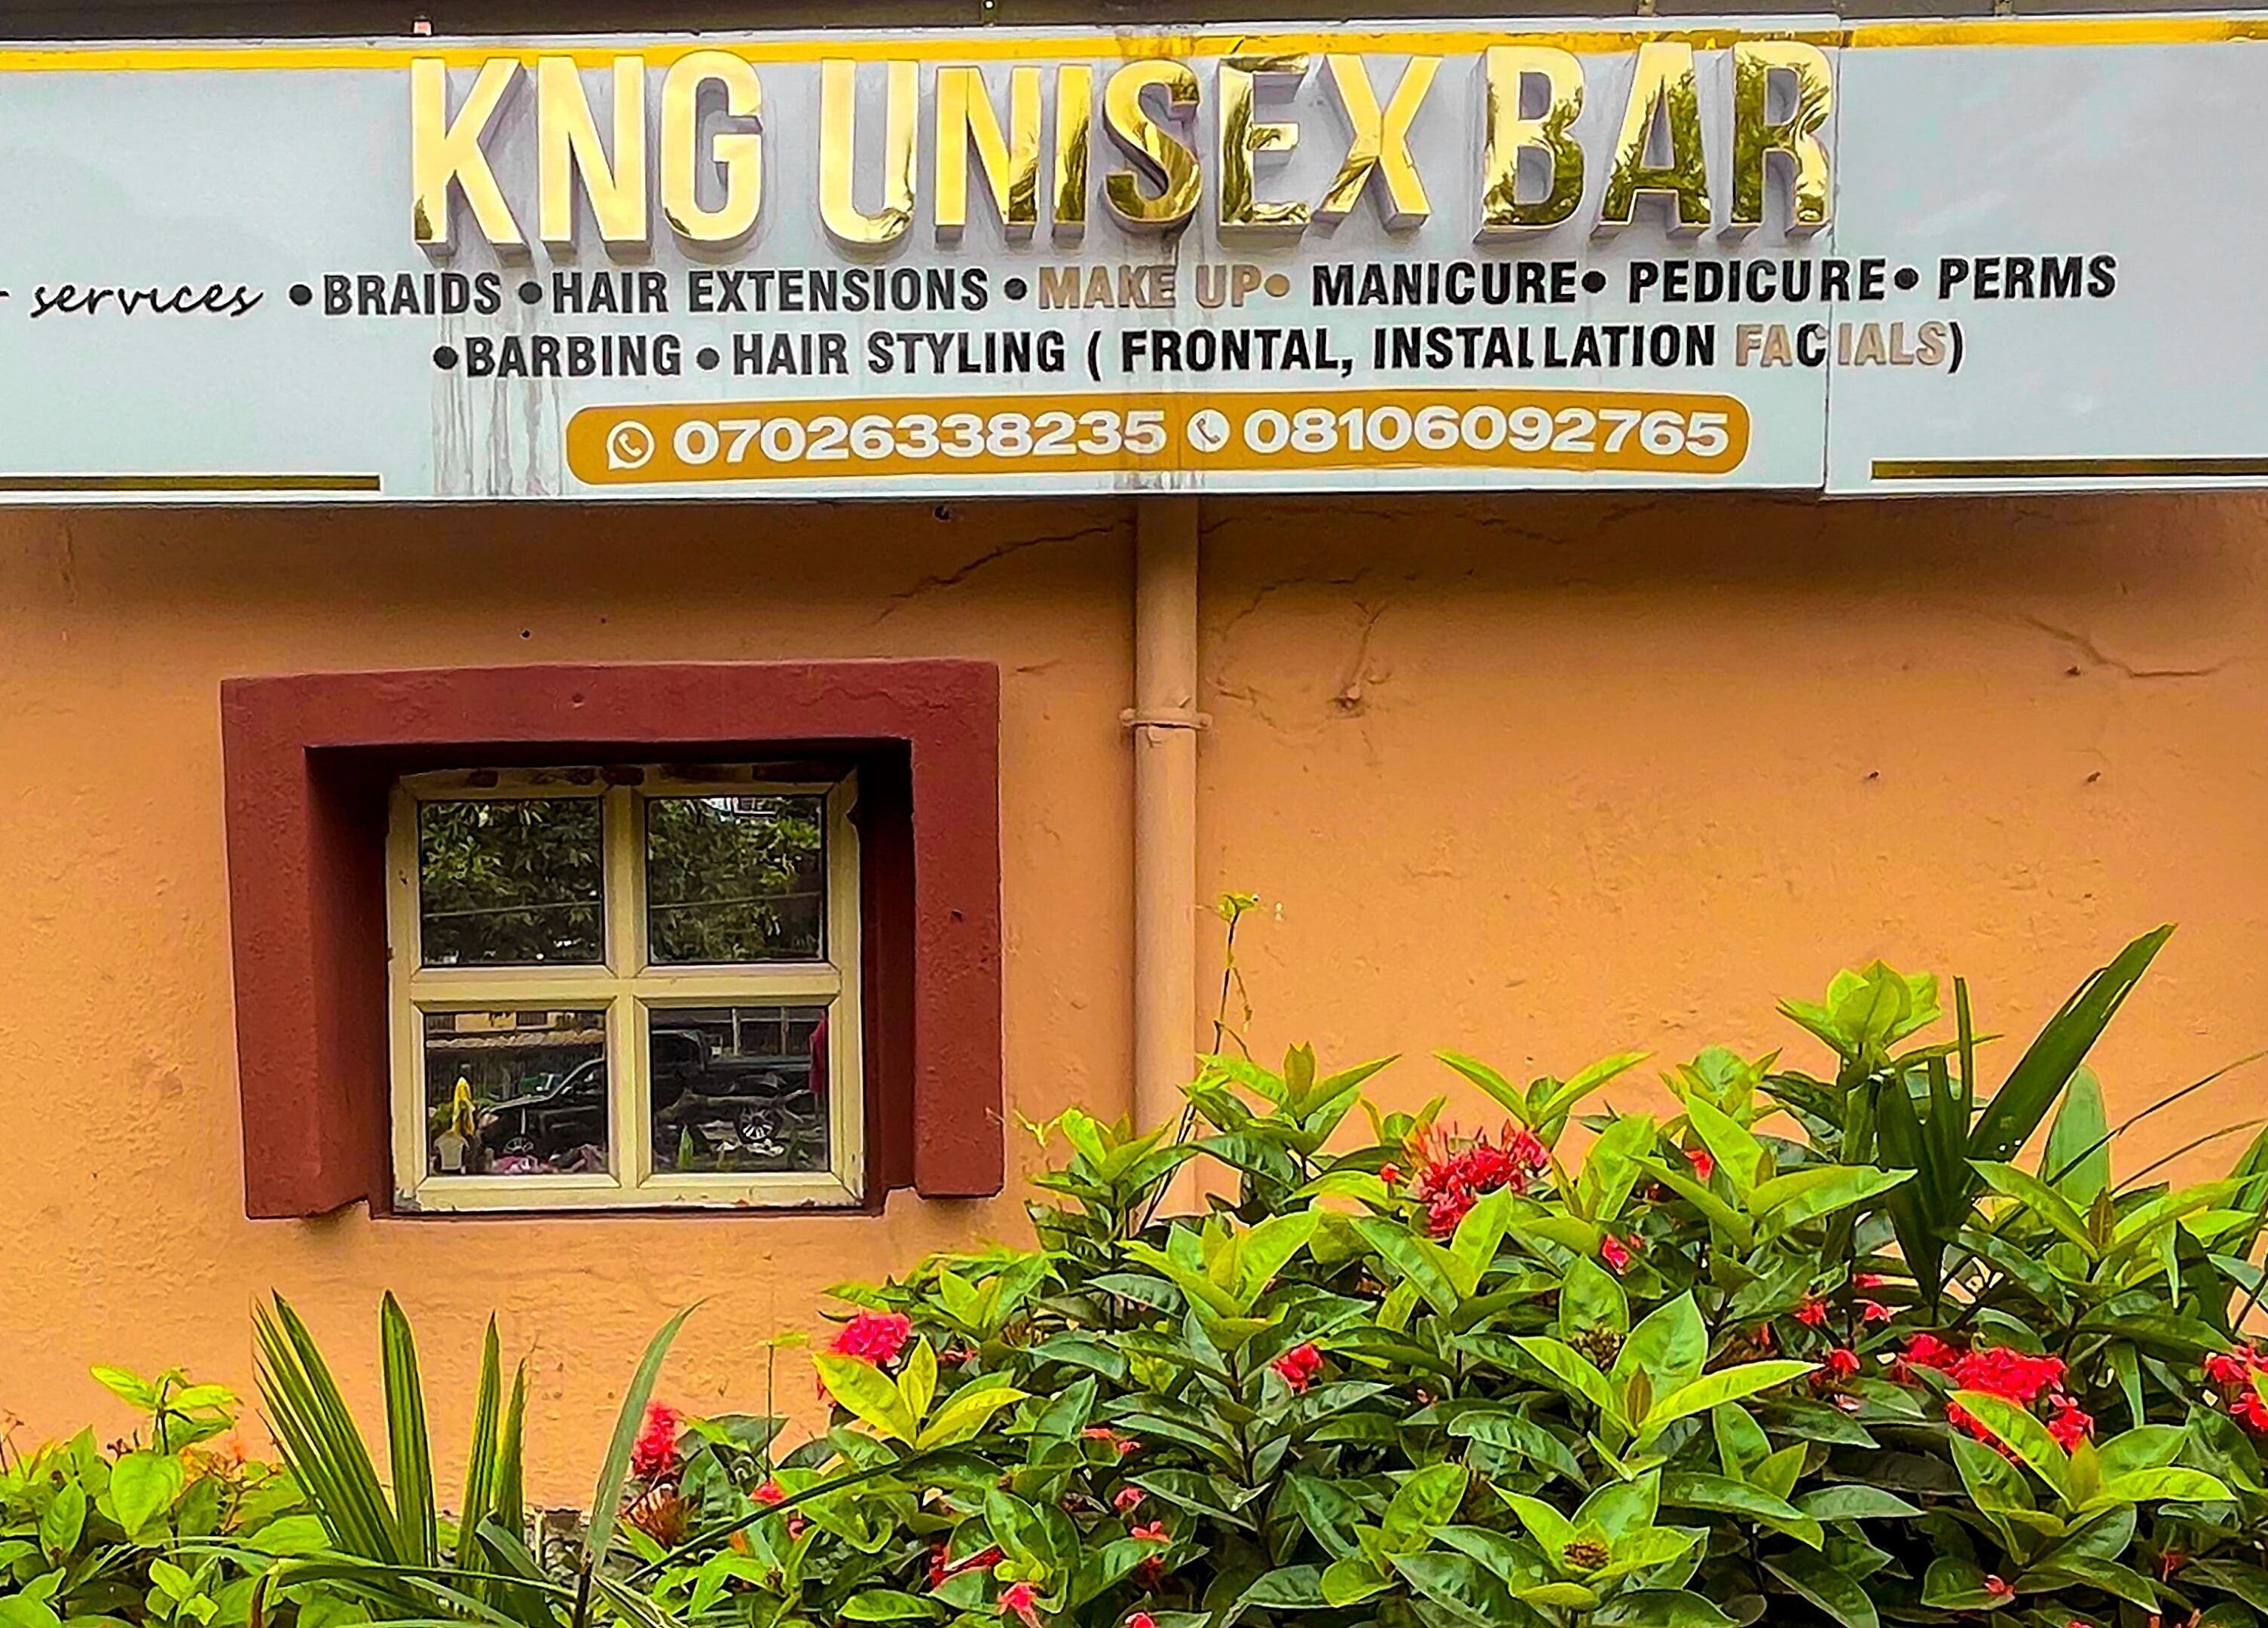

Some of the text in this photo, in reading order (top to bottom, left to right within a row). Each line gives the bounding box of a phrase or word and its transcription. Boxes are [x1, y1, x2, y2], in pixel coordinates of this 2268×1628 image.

[411, 41, 1835, 244] KNG UNISEX BAR
[30, 283, 264, 318] services
[552, 271, 668, 314] HAIR
[688, 268, 988, 311] EXTENSIONS
[1038, 266, 1176, 308] MAKE
[1939, 255, 2117, 298] PERMS
[732, 334, 848, 375] HAIR
[867, 332, 1065, 374] STYLING
[1374, 325, 1716, 370] INSTALLATION
[1735, 322, 1964, 373] FACIALS)
[673, 410, 1166, 461] 07026338235
[1244, 407, 1729, 456] 08106092765
